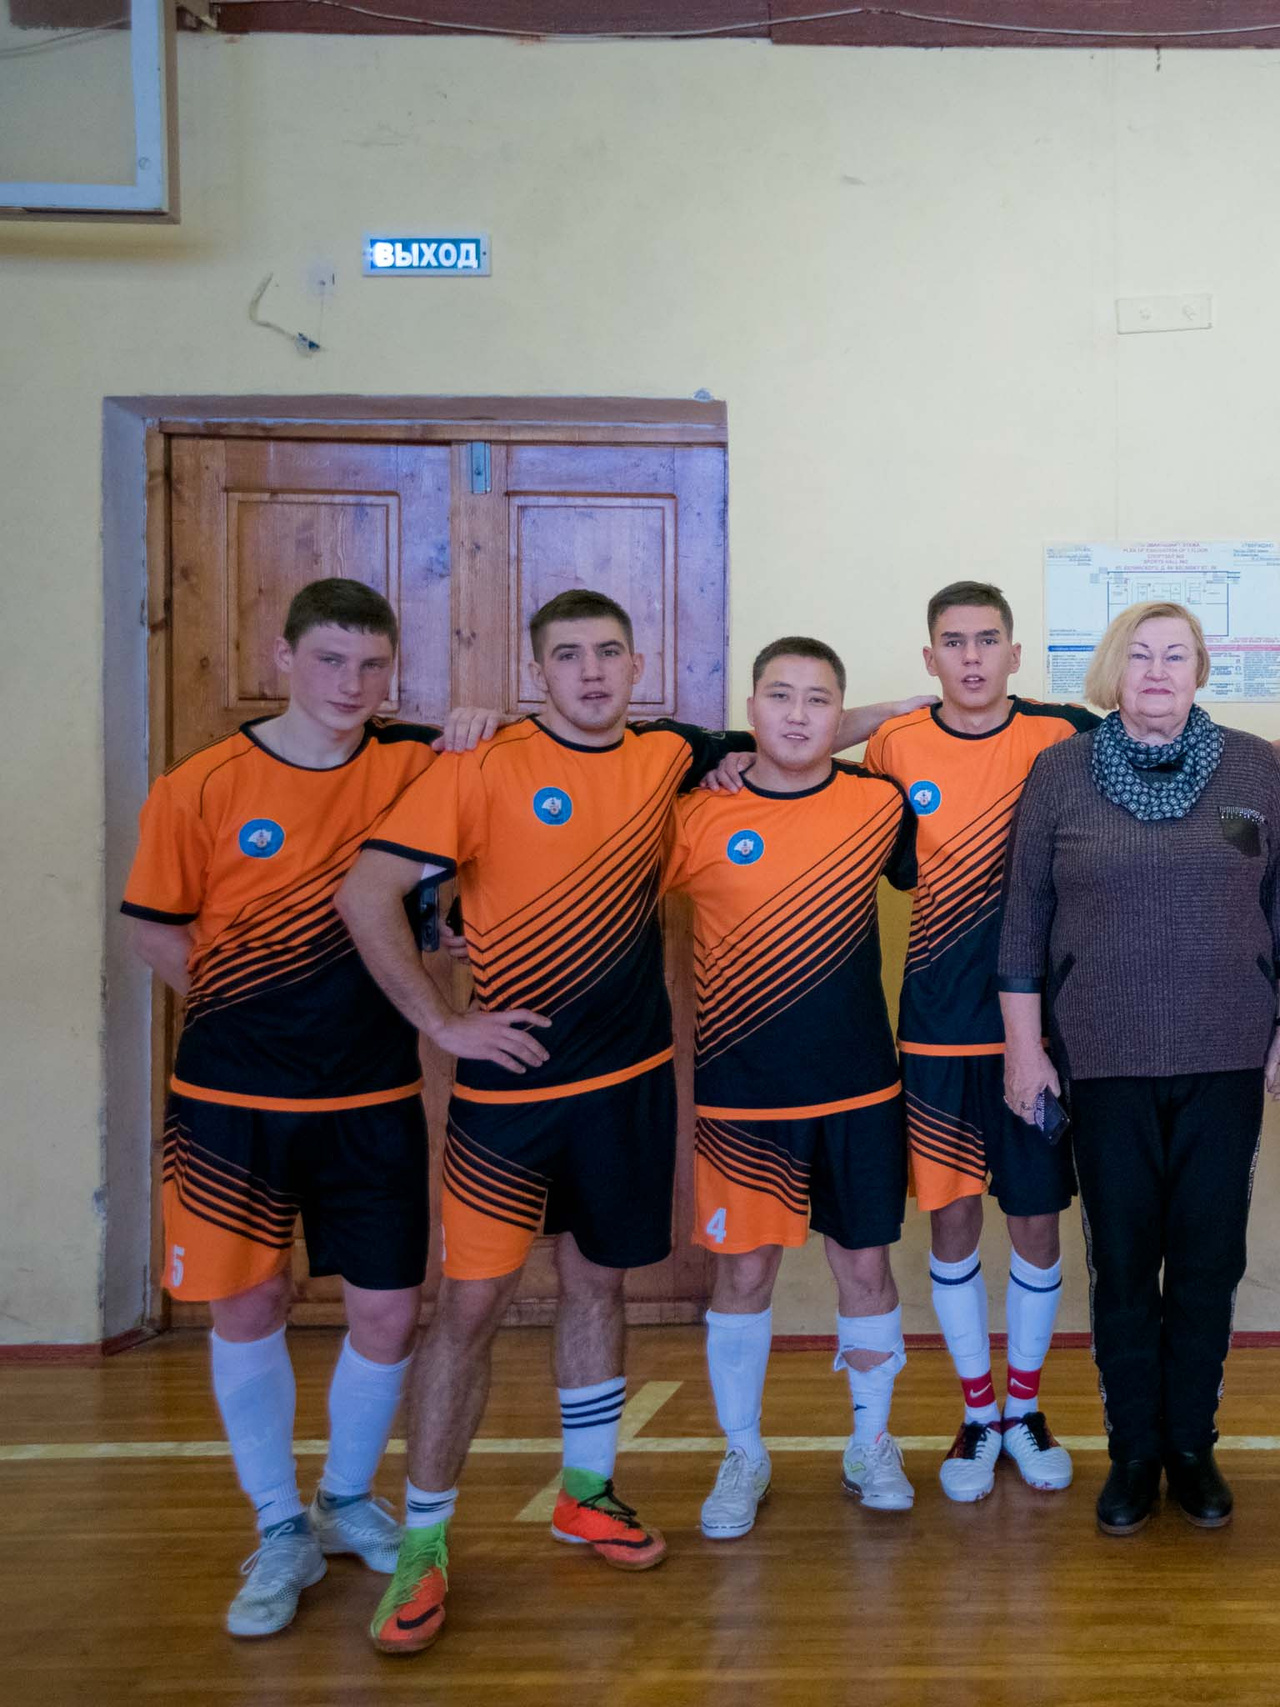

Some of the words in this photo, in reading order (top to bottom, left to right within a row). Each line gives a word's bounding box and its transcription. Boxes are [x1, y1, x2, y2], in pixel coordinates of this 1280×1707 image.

[373, 242, 479, 269] ВЫХОД
[706, 1207, 727, 1244] 4
[172, 1244, 185, 1288] 5
